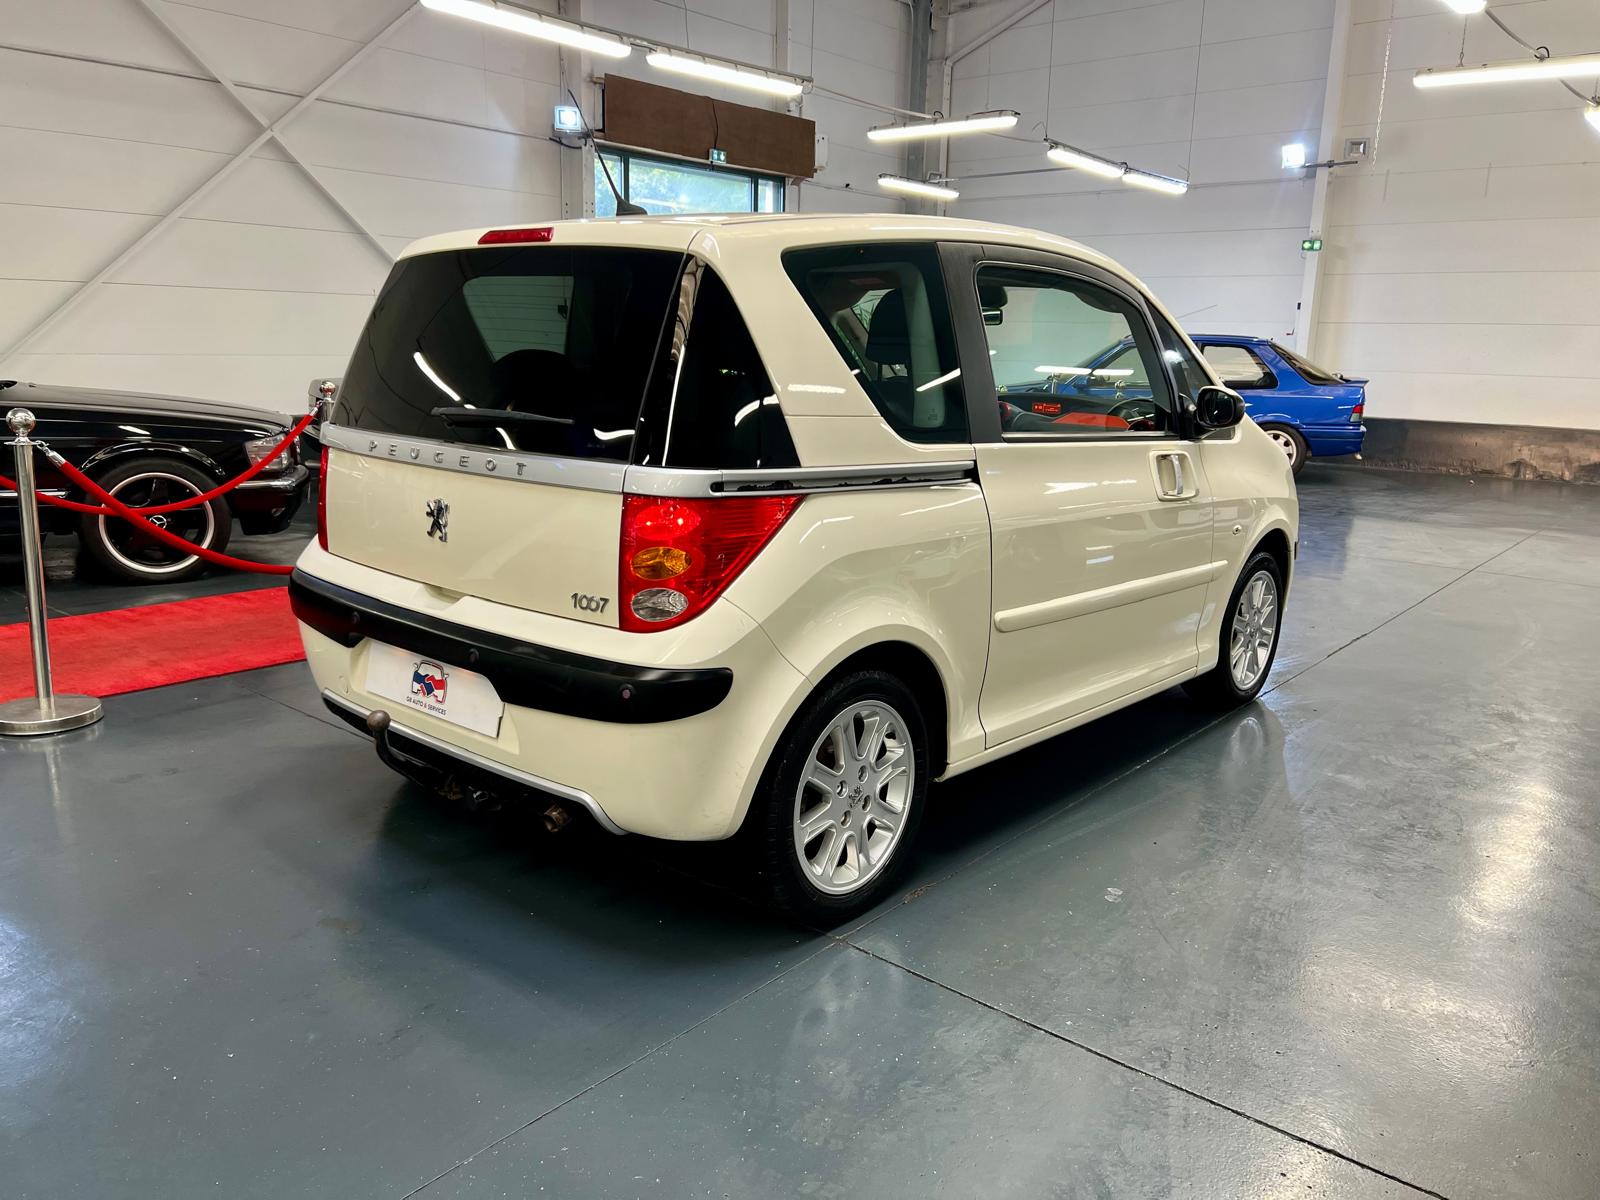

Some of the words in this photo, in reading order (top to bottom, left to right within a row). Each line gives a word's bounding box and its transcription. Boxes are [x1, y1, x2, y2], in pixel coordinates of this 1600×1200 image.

[368, 439, 527, 476] PEUGEOT
[412, 698, 424, 707] AUTO
[427, 704, 447, 716] SERVICES
